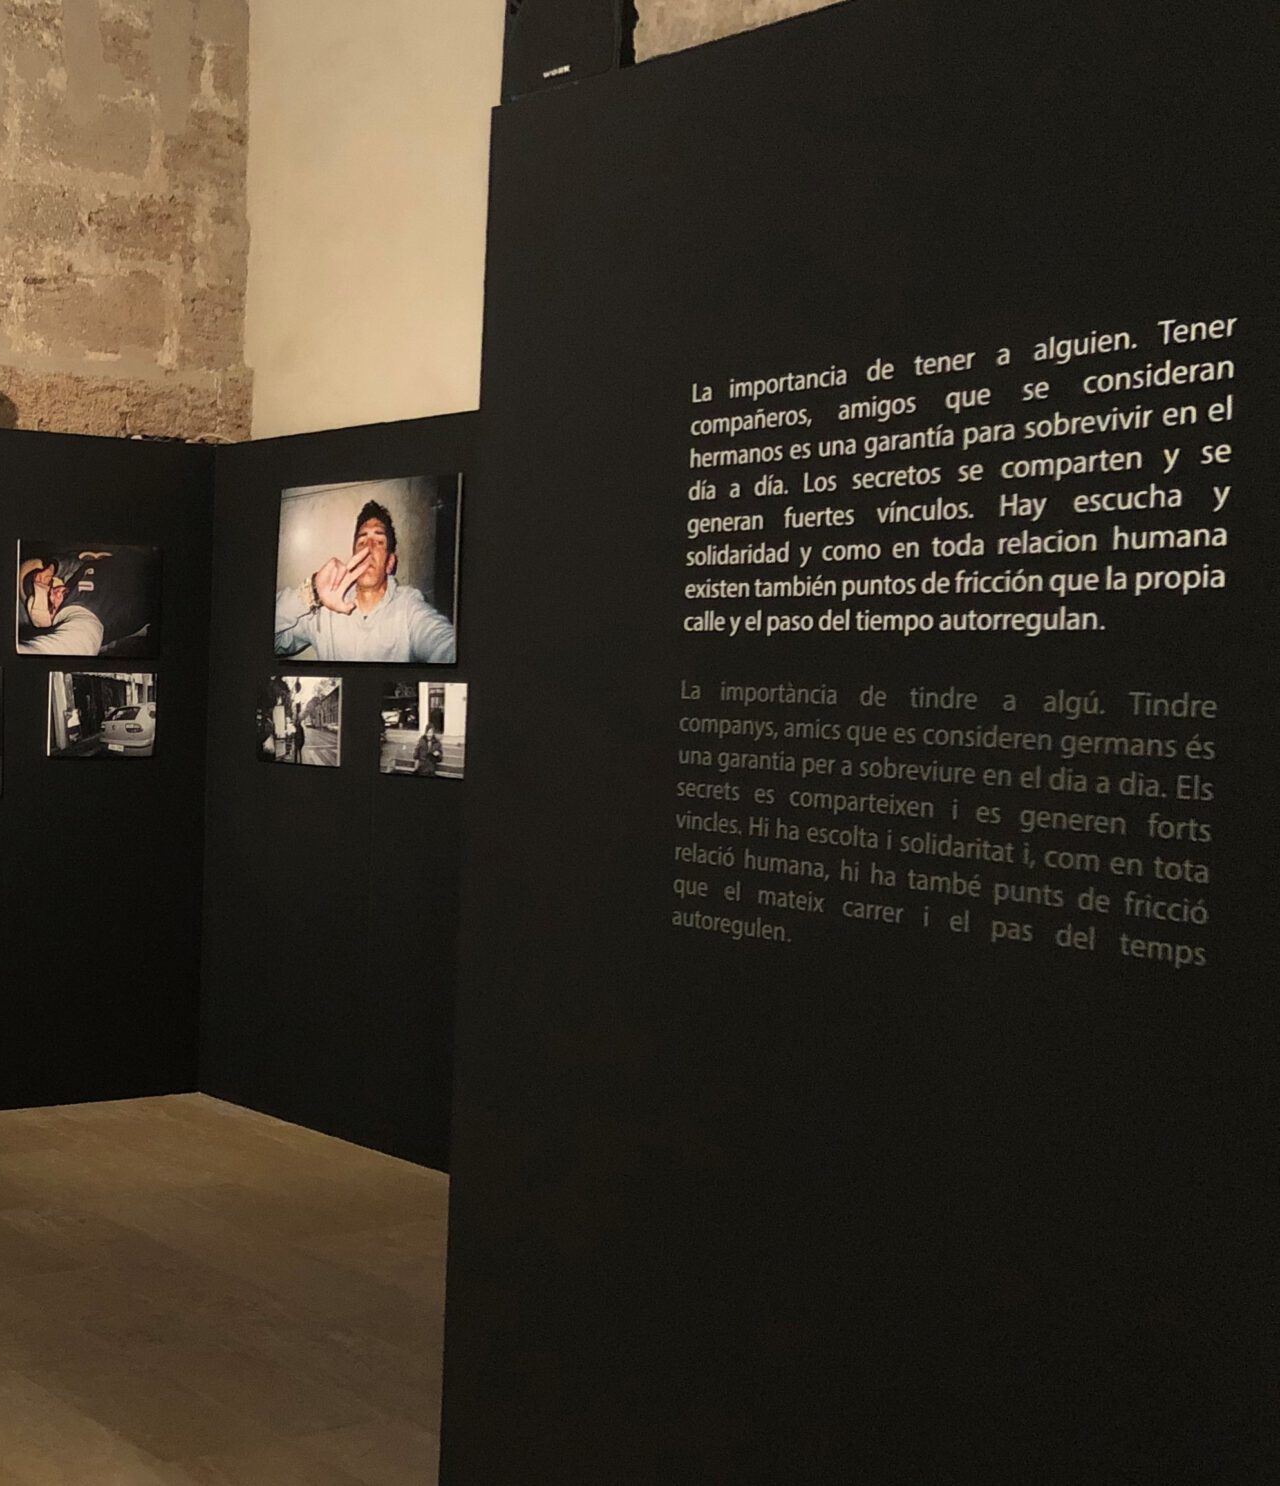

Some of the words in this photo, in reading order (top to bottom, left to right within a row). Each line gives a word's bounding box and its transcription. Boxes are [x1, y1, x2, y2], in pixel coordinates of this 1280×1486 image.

[691, 382, 713, 404] La
[729, 364, 848, 401] importancia
[866, 357, 895, 382] de
[913, 351, 976, 376] tener
[995, 347, 1011, 366] a
[1033, 329, 1138, 365] alguien.
[1157, 317, 1238, 345] Tener
[690, 408, 813, 438] compañeros,
[837, 395, 917, 423] amigos
[944, 387, 992, 414] que
[1022, 380, 1050, 402] se
[1082, 359, 1235, 395] consideran
[689, 444, 784, 469] hermanos
[789, 442, 812, 460] es
[818, 437, 857, 458] una
[863, 423, 955, 460] garantía
[962, 423, 1016, 451] para
[1023, 404, 1154, 440] sobrevivir
[1162, 405, 1198, 427] en
[1207, 393, 1234, 423] el
[687, 479, 717, 502] día
[728, 482, 741, 499] a
[753, 474, 789, 497] día.
[803, 471, 838, 494] Los
[851, 465, 942, 490] secretos
[957, 463, 984, 483] se
[1000, 449, 1143, 482] comparten
[1163, 447, 1181, 475] y
[1200, 443, 1233, 465] se
[686, 514, 764, 540] generan
[783, 505, 855, 529] fuertes
[876, 496, 975, 524] vínculos.
[999, 492, 1048, 522] Hay
[1072, 482, 1183, 514] escucha
[1212, 485, 1232, 513] y
[685, 540, 790, 567] solidaridad
[799, 546, 813, 568] y
[821, 542, 882, 562] como
[891, 541, 920, 560] en
[931, 532, 985, 558] toda
[997, 528, 1098, 555] relacion
[1112, 524, 1228, 551] humana
[684, 578, 751, 600] existen
[753, 574, 837, 598] también
[841, 574, 917, 602] puntos
[920, 570, 951, 595] de
[954, 568, 1044, 594] fricción
[1048, 572, 1100, 598] que
[1105, 564, 1128, 591] la
[1134, 563, 1226, 597] propia
[683, 609, 726, 632] calle
[729, 615, 742, 637] y
[744, 609, 763, 632] el
[766, 614, 815, 637] paso
[817, 608, 851, 632] del
[855, 609, 935, 637] tiempo
[938, 605, 1106, 638] autorregulan.
[680, 679, 701, 700] La
[720, 680, 838, 707] importància
[859, 684, 888, 708] de
[909, 685, 978, 711] tindre
[1002, 693, 1017, 712] a
[1042, 688, 1106, 721] algú.
[1128, 690, 1218, 719] Tindre
[679, 716, 779, 742] companys,
[783, 718, 841, 741] amics
[846, 724, 888, 747] que
[892, 726, 917, 745] es
[922, 724, 1053, 751] consideren
[1059, 734, 1178, 759] germans
[1185, 733, 1216, 761] és
[678, 749, 713, 766] una
[717, 750, 796, 773] garantia
[801, 757, 836, 778] per
[840, 759, 853, 776] a
[859, 755, 976, 785] sobreviure
[982, 768, 1012, 787] en
[1019, 765, 1042, 789] el
[1048, 766, 1088, 793] dia
[1095, 775, 1111, 794] a
[1118, 770, 1168, 799] dia.
[1176, 774, 1215, 802] Els
[676, 781, 741, 802] secrets
[753, 787, 775, 805] es
[788, 790, 934, 818] comparteixen
[952, 798, 959, 820] i
[975, 805, 1002, 824] es
[1019, 809, 1127, 835] generen
[1147, 812, 1212, 843] forts
[675, 810, 742, 835] vincles.
[748, 816, 770, 838] Hi
[775, 817, 800, 841] ha
[806, 824, 879, 849] escolta
[886, 829, 892, 851] i
[899, 831, 1015, 864] solidaritat
[1023, 841, 1036, 869] i,
[1043, 849, 1100, 873] com
[1109, 856, 1143, 877] en
[1153, 856, 1210, 884] tota
[674, 842, 735, 868] relació
[743, 847, 830, 882] humana,
[839, 858, 860, 883] hi
[870, 861, 897, 887] ha
[907, 868, 982, 898] també
[993, 882, 1065, 908] punts
[1077, 886, 1111, 913] de
[1123, 890, 1209, 925] fricció
[671, 910, 792, 943] autoregulen.
[673, 878, 709, 899] que
[723, 880, 741, 902] el
[757, 889, 825, 913] mateix
[841, 900, 905, 924] carrer
[923, 905, 930, 928] i
[949, 909, 970, 933] el
[990, 920, 1033, 943] pas
[1055, 923, 1096, 951] del
[1119, 932, 1207, 969] temps
